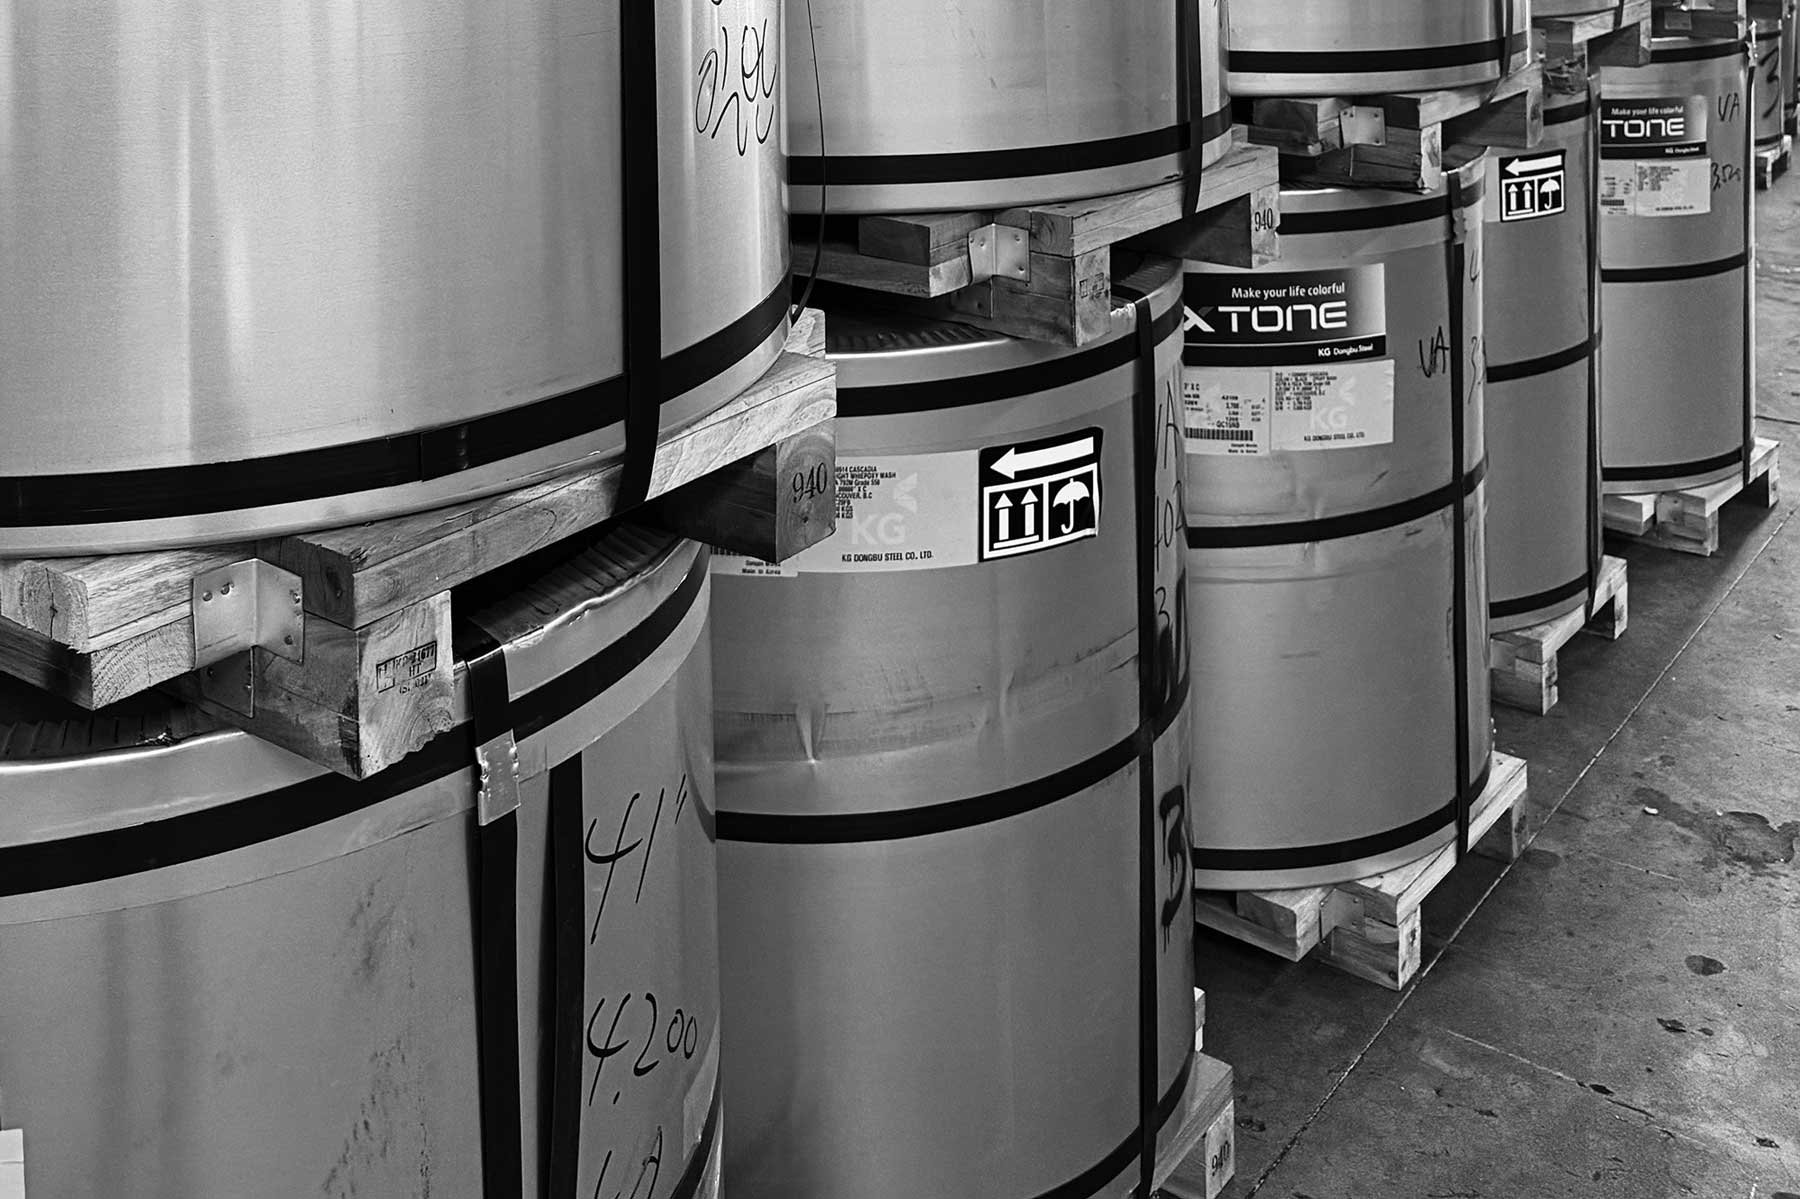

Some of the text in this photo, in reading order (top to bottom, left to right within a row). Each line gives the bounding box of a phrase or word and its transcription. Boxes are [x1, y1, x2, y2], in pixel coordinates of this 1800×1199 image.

[1254, 208, 1273, 232] 940
[1231, 282, 1345, 301] Make your life colorful
[1318, 348, 1331, 357] KG
[792, 463, 828, 504] 940
[842, 554, 852, 562] KG
[853, 553, 883, 562] DONGBU
[884, 552, 903, 560] STEEL
[585, 774, 688, 945] 41"
